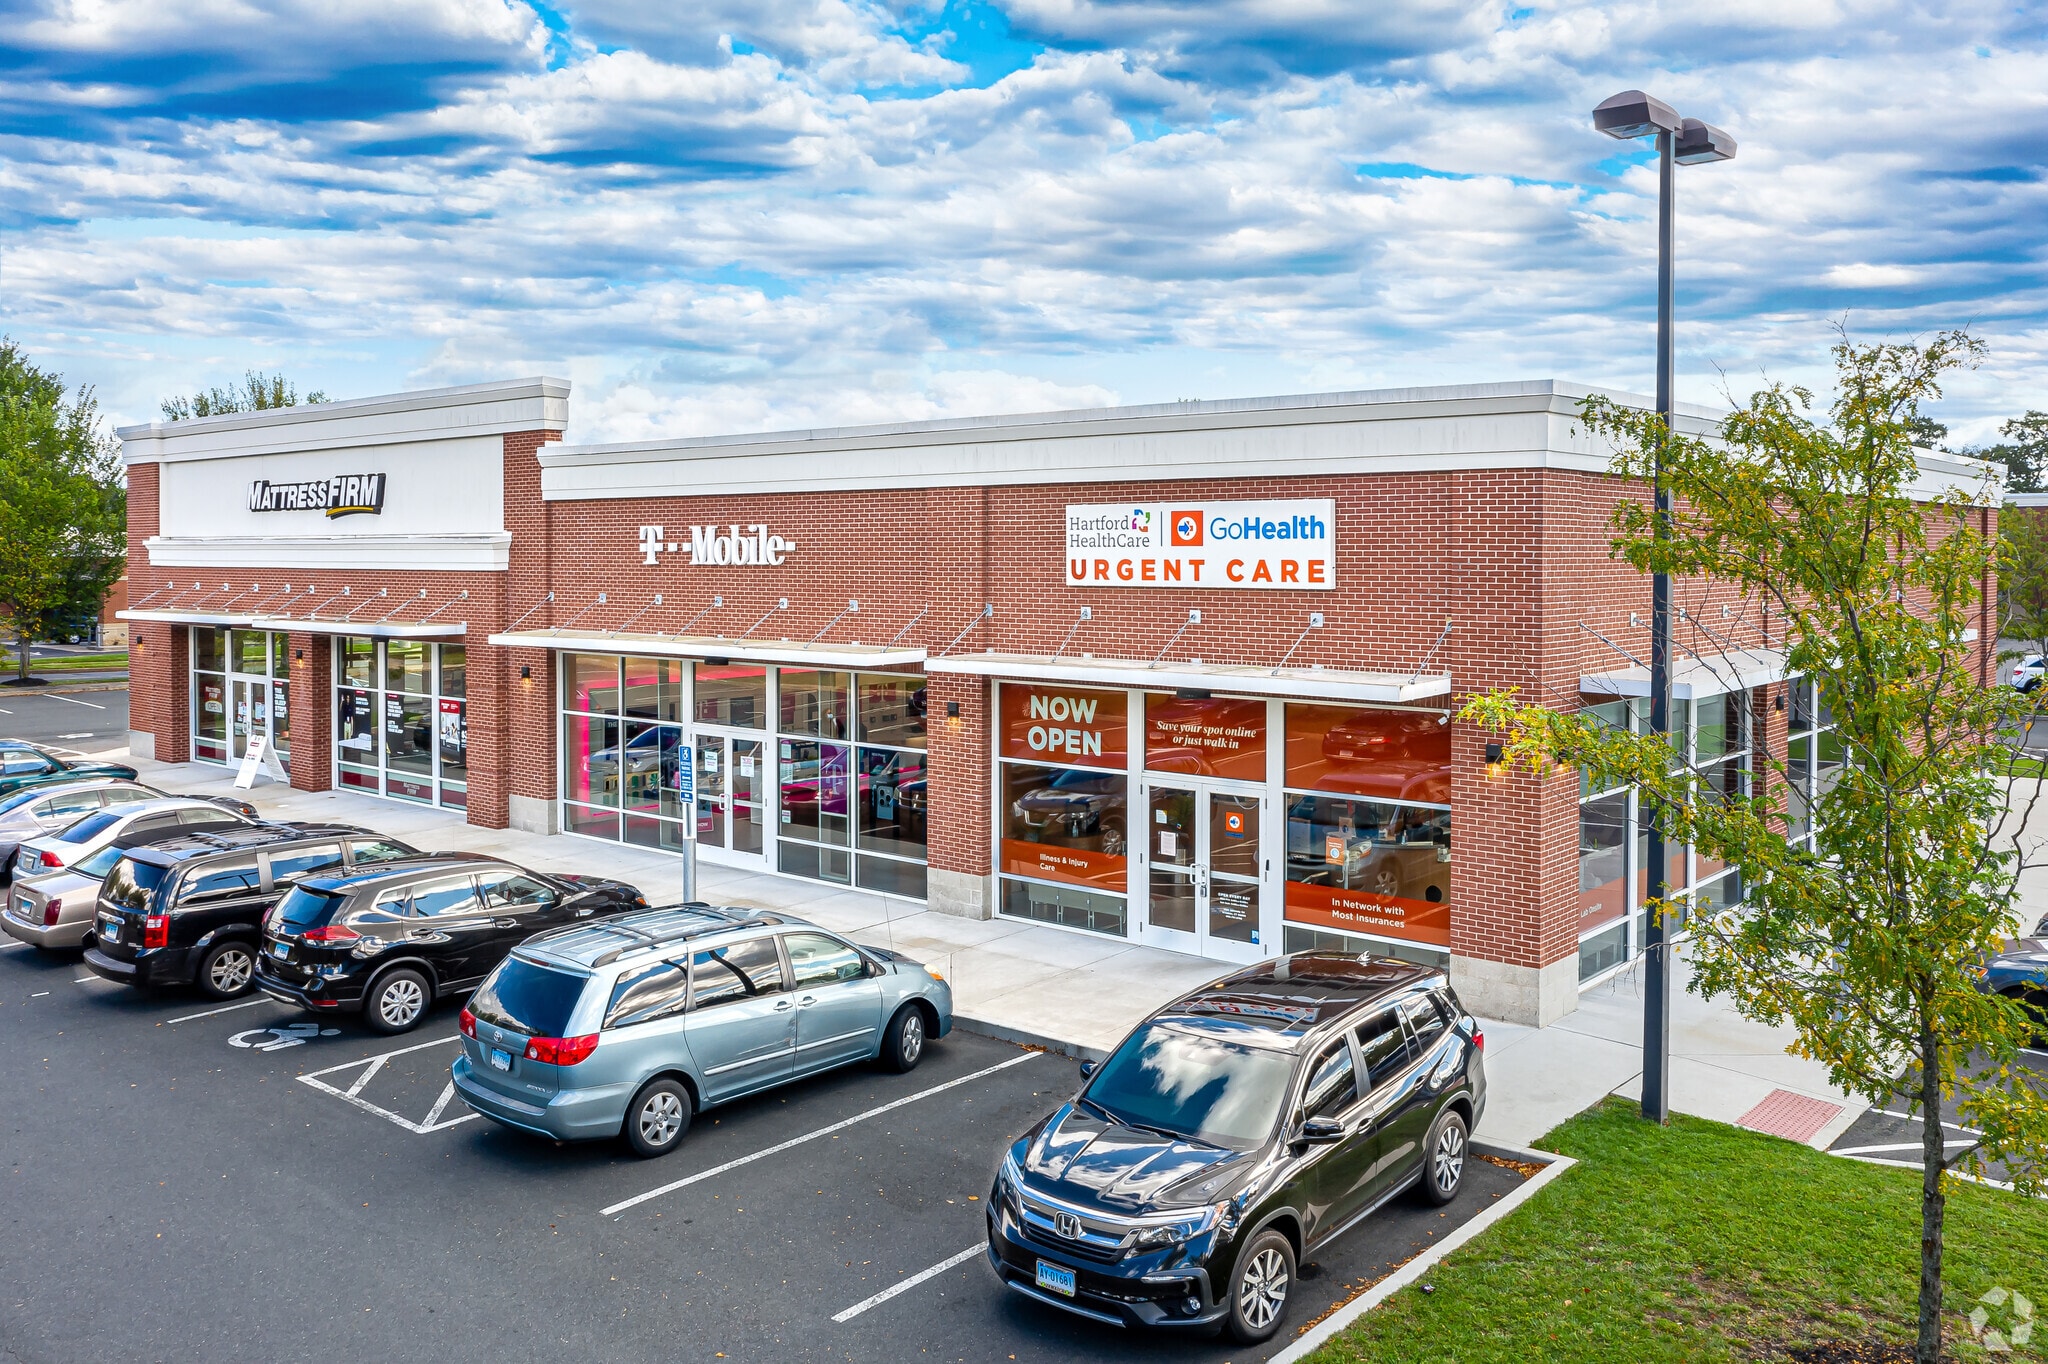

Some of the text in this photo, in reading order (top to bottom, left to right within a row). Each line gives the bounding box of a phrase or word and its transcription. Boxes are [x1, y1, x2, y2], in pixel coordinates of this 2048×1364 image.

[1069, 515, 1129, 531] Hartford
[1210, 515, 1325, 540] GoHealth
[1070, 533, 1150, 548] HealthCare
[1071, 558, 1325, 583] URGENT CARE
[1030, 695, 1097, 724] NOW
[1157, 720, 1257, 738] Save your spot online
[1027, 726, 1102, 757] OPEN
[1172, 734, 1239, 749] or just walk in
[1040, 853, 1061, 864] Illness
[1068, 858, 1088, 868] Injury
[1040, 862, 1056, 872] Care
[1332, 897, 1405, 916] In Network with
[1332, 910, 1405, 929] Most Insurances
